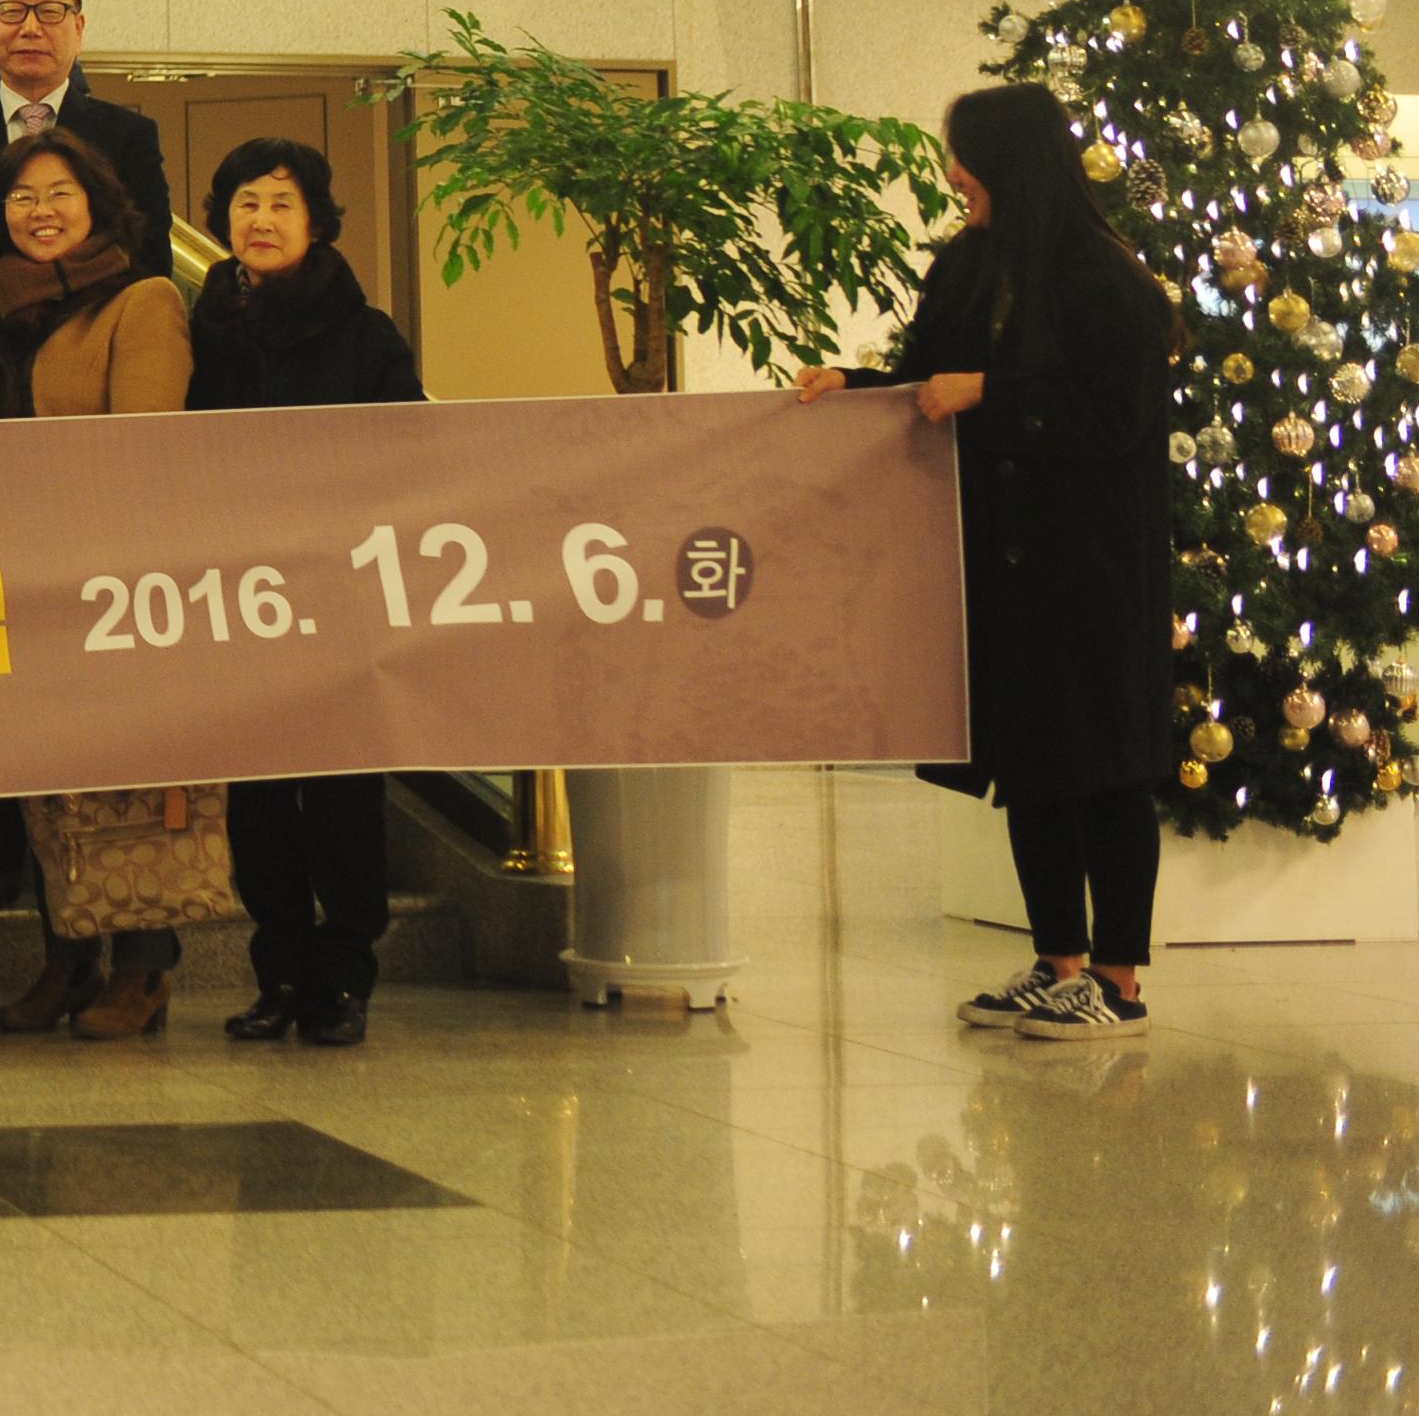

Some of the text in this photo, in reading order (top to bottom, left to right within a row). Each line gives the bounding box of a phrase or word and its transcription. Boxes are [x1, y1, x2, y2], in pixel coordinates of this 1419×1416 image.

[81, 522, 746, 653] 2016. 12. 6. 화
